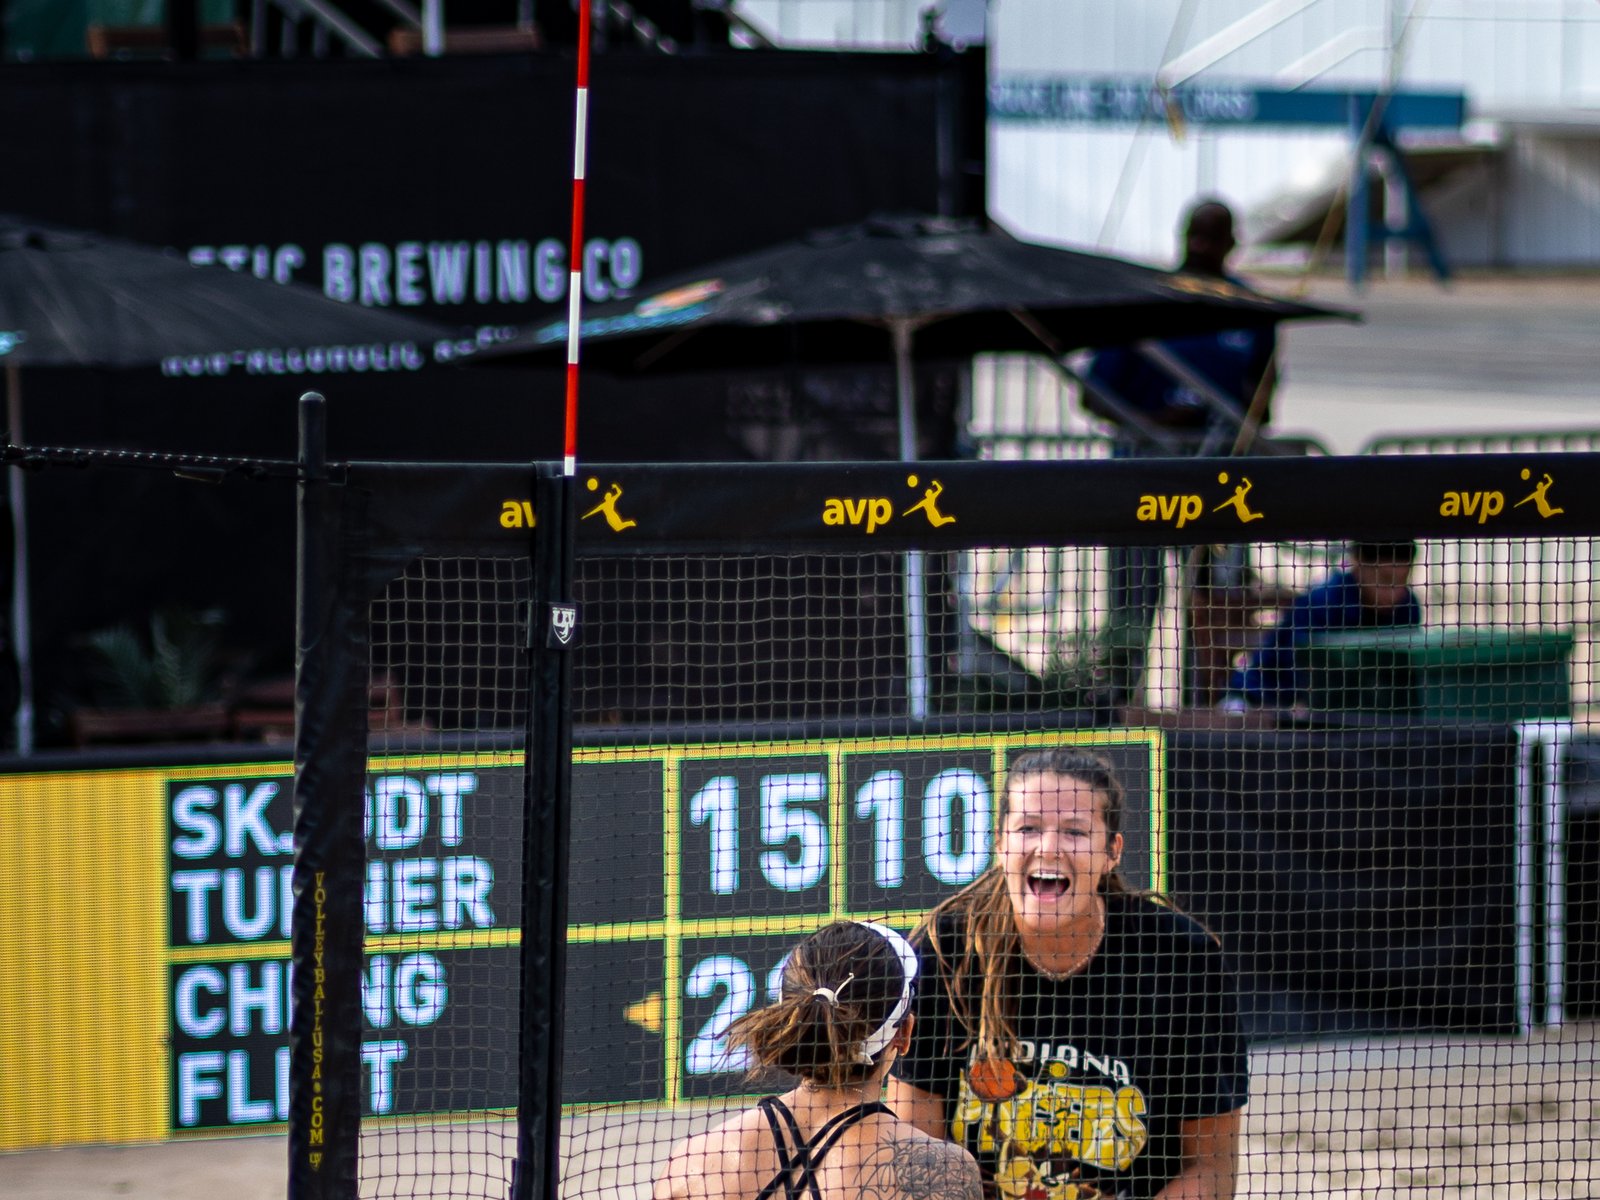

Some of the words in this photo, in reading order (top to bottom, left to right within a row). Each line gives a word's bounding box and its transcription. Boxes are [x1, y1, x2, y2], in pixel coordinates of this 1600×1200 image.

[323, 239, 566, 305] BREWING
[500, 501, 537, 528] av
[822, 497, 893, 533] avp
[1136, 494, 1203, 528] avp
[1439, 490, 1504, 524] avp
[172, 772, 480, 860] SKDT
[690, 772, 829, 895] 15
[855, 767, 993, 886] 10
[171, 856, 496, 943] TUER
[685, 952, 791, 1075] 2
[178, 1039, 408, 1127] FLIT
